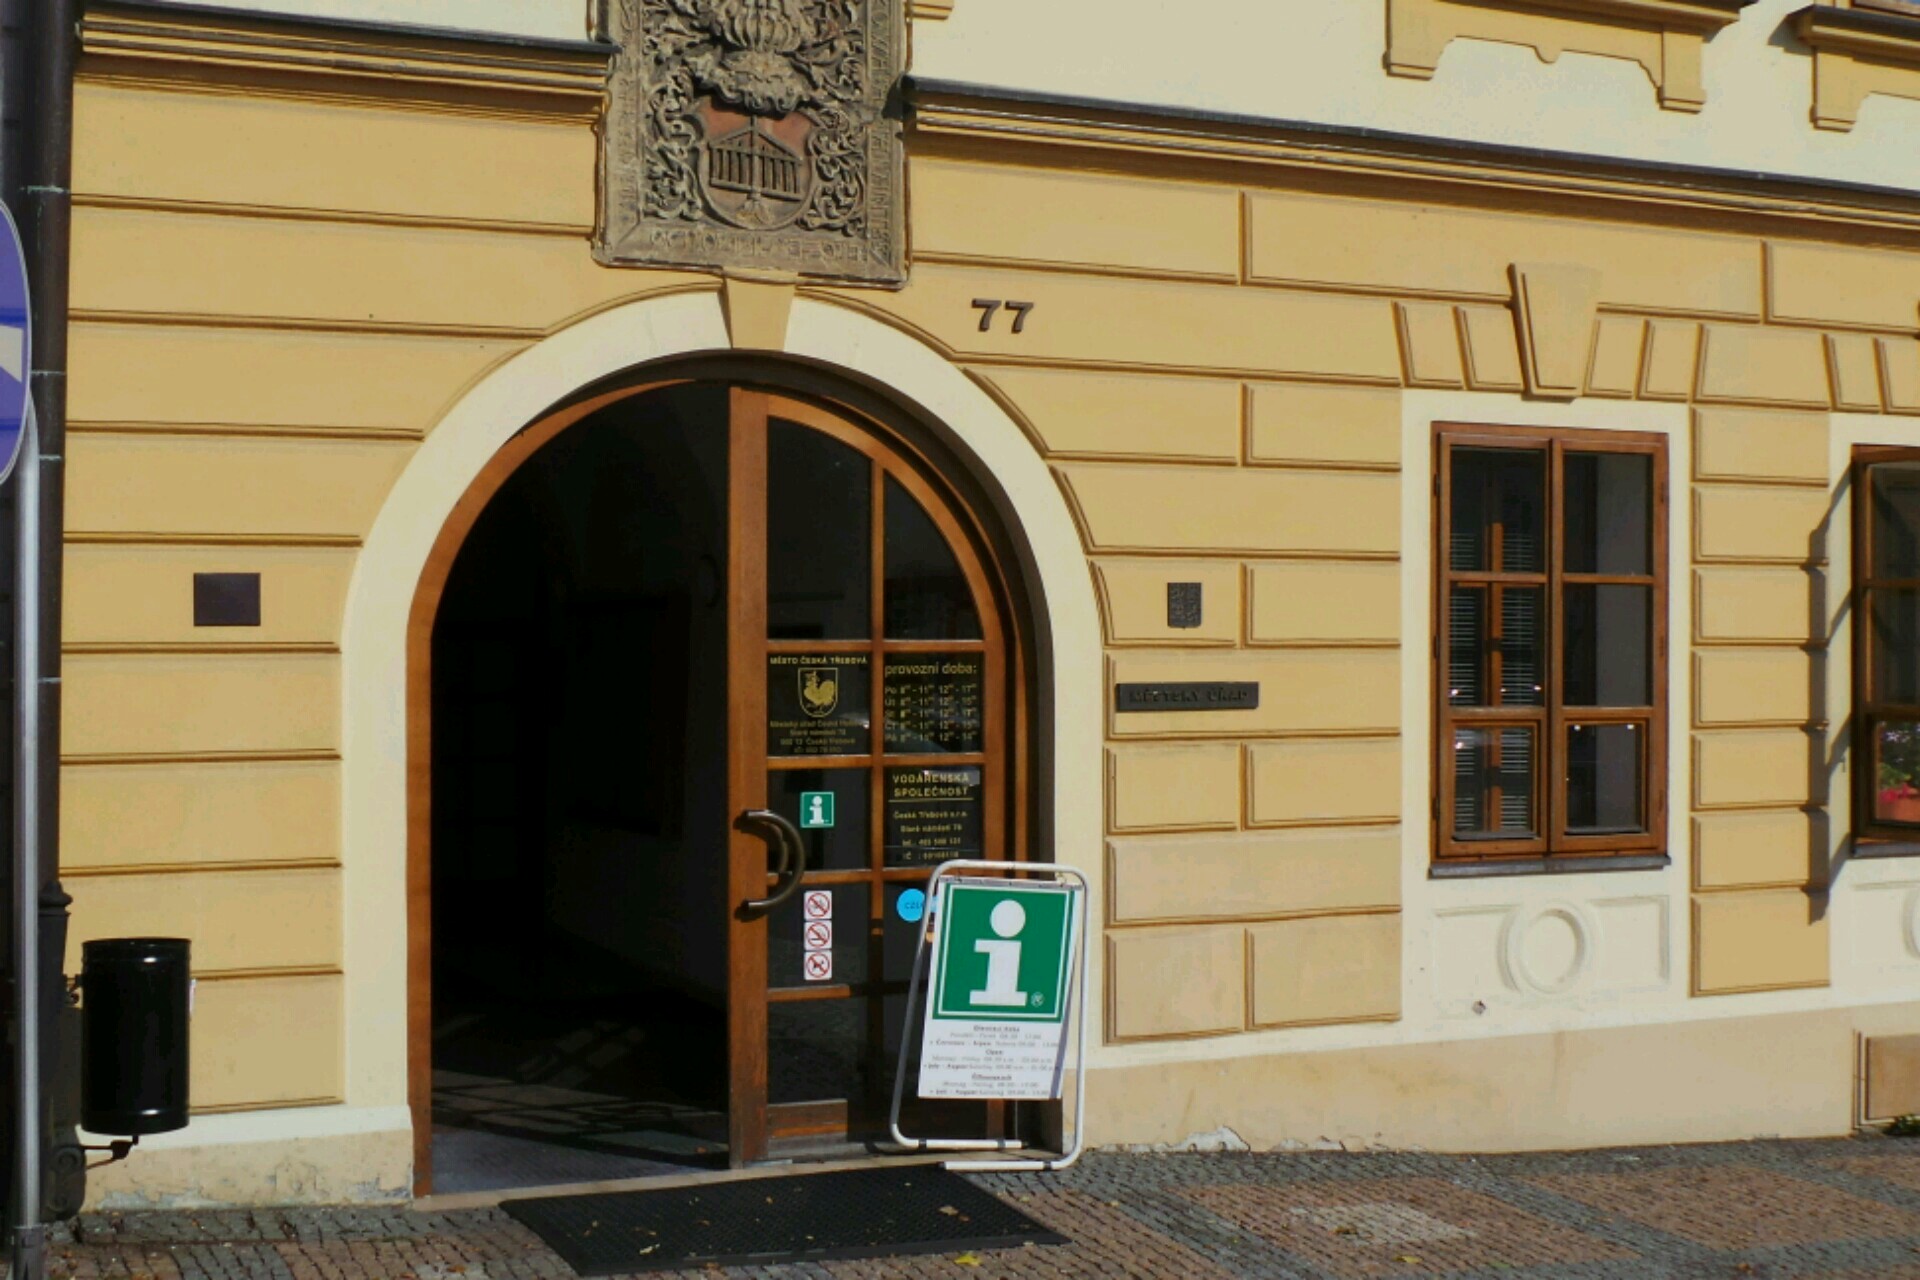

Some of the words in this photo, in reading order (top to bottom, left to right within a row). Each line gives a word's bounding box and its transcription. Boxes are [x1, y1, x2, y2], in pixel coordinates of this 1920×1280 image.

[971, 298, 1034, 334] 77
[800, 656, 827, 665] ČESKÁ
[831, 656, 867, 665] TŘEBOVÁ
[885, 661, 939, 678] provozní
[894, 785, 968, 797] SPOLEČNOST
